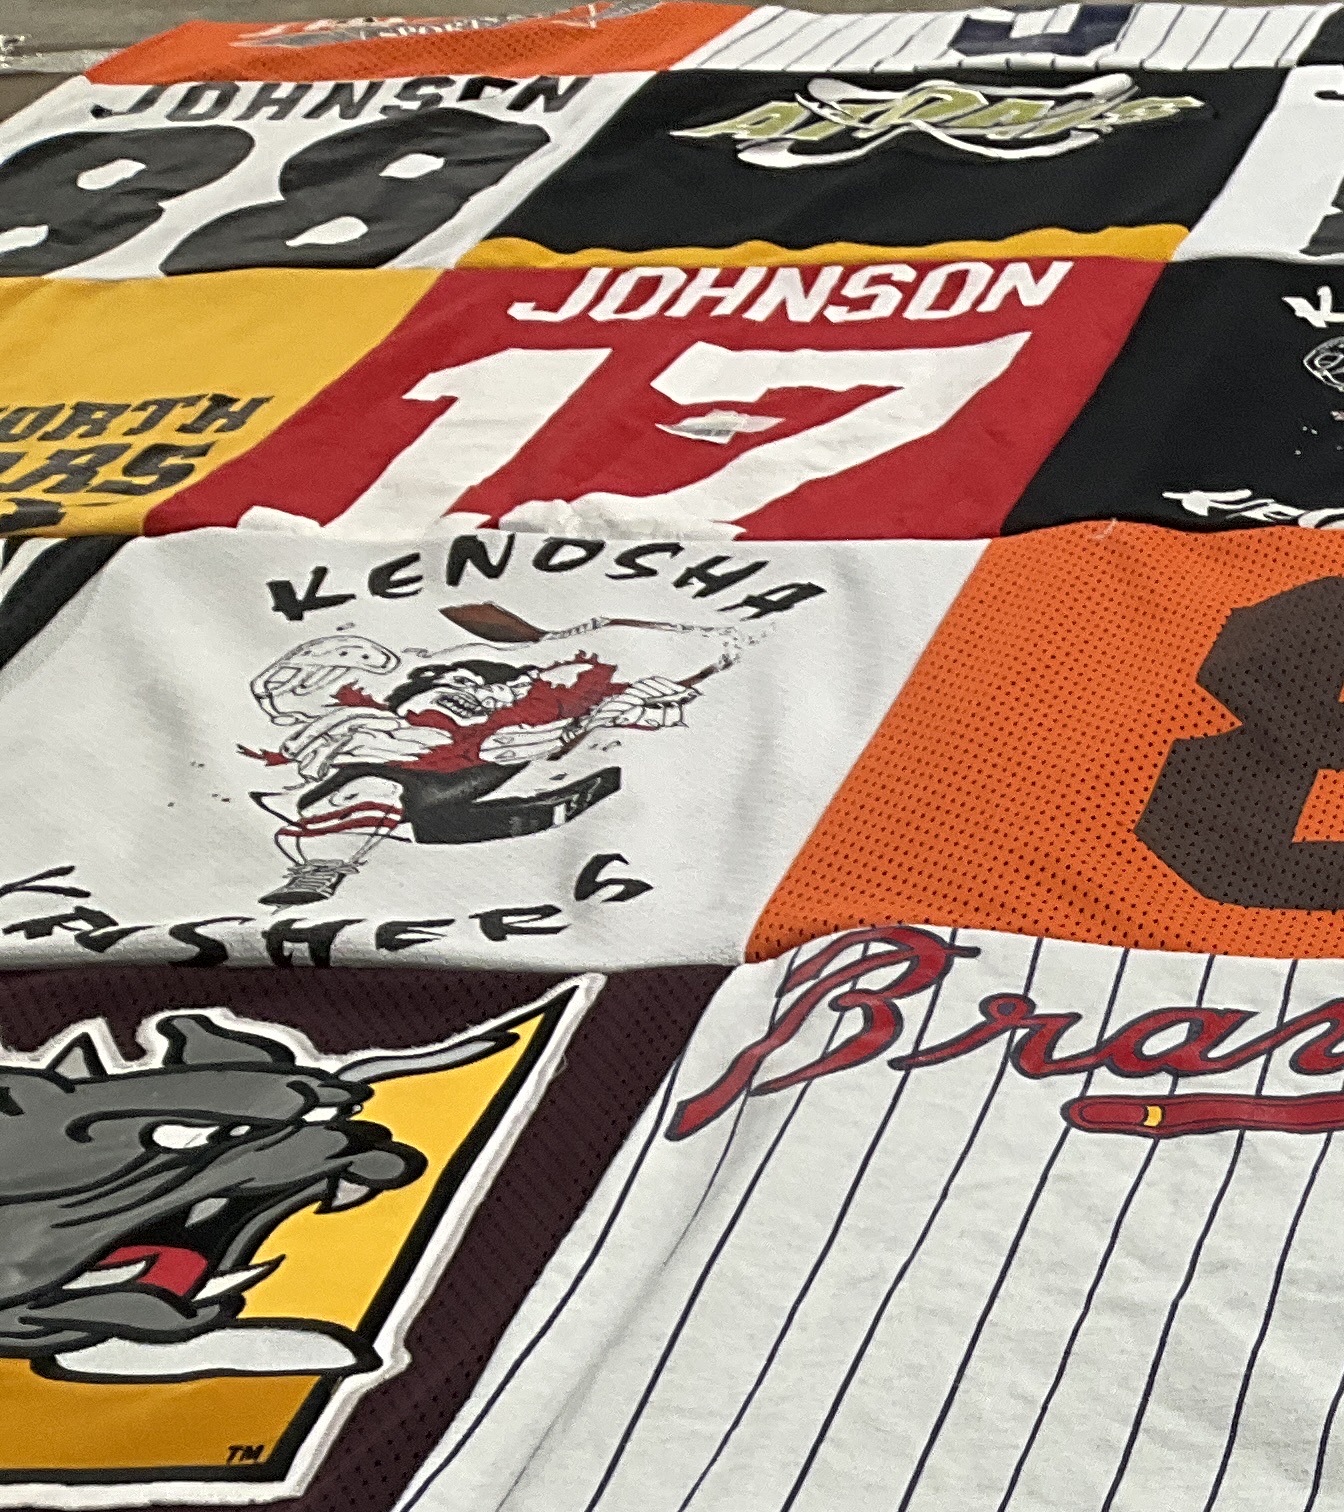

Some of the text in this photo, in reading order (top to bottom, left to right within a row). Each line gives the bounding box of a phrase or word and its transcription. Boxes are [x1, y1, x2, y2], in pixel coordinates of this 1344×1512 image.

[507, 261, 1075, 323] JOHNSON
[0, 393, 275, 442] ORTH
[238, 331, 1033, 545] 17
[266, 534, 827, 622] KENOSHA
[226, 1444, 265, 1465] TM
